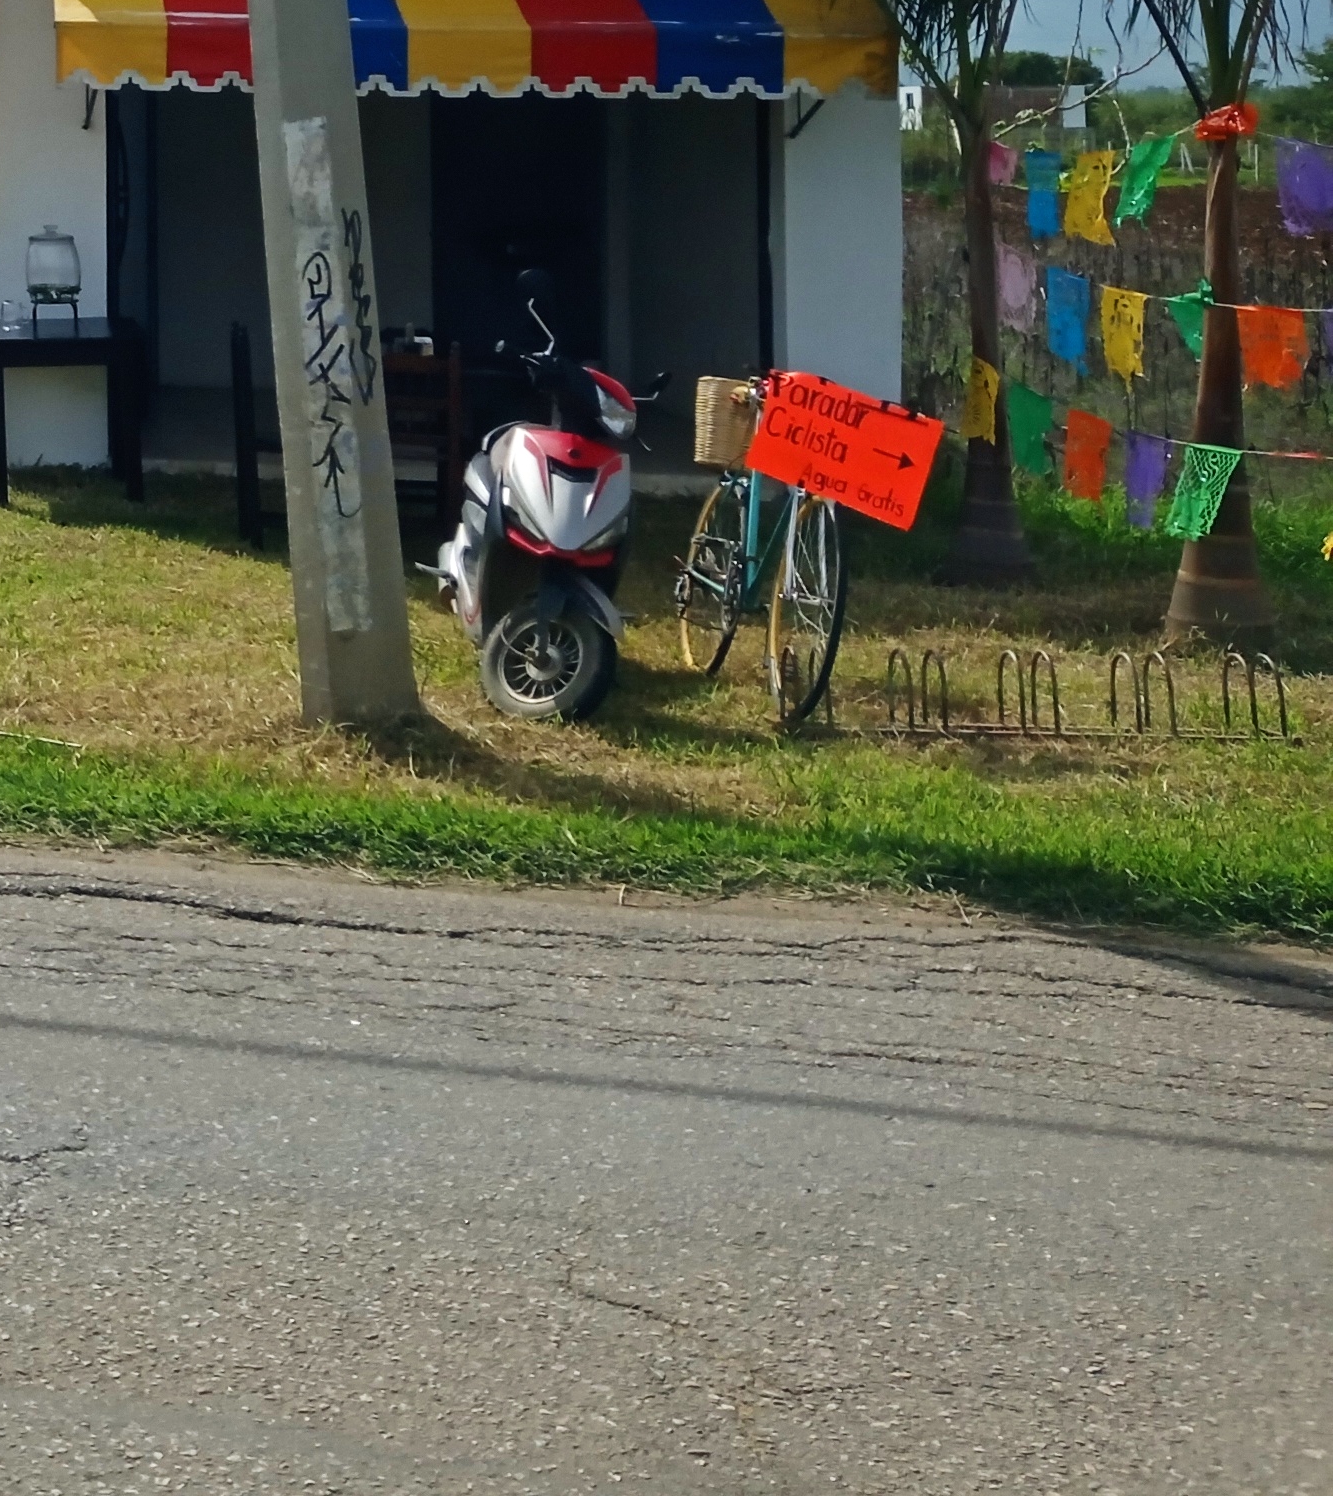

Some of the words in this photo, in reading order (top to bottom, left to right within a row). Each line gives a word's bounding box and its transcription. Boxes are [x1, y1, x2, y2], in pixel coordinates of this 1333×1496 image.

[771, 374, 869, 429] Parador
[765, 406, 849, 462] Ciclista
[801, 464, 848, 493] Agua
[857, 483, 905, 517] Gratis
